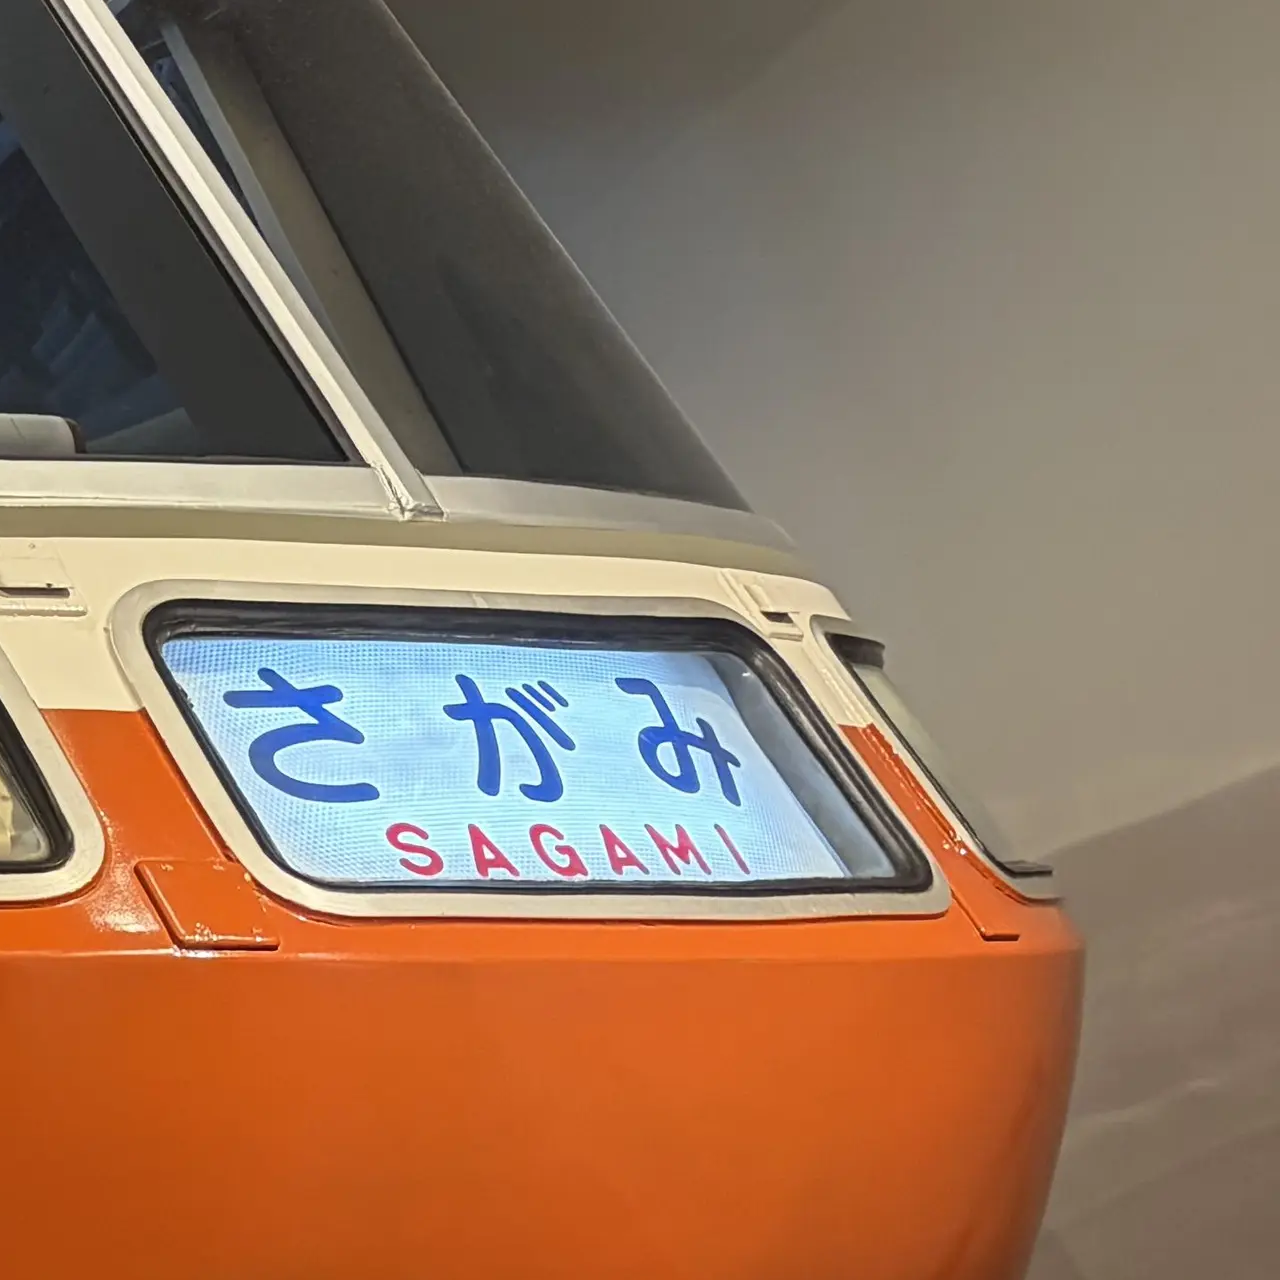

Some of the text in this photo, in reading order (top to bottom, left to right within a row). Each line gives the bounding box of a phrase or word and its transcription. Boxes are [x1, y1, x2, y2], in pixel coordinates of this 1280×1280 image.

[223, 667, 741, 807] さがみ
[385, 822, 752, 878] SAGAMI
